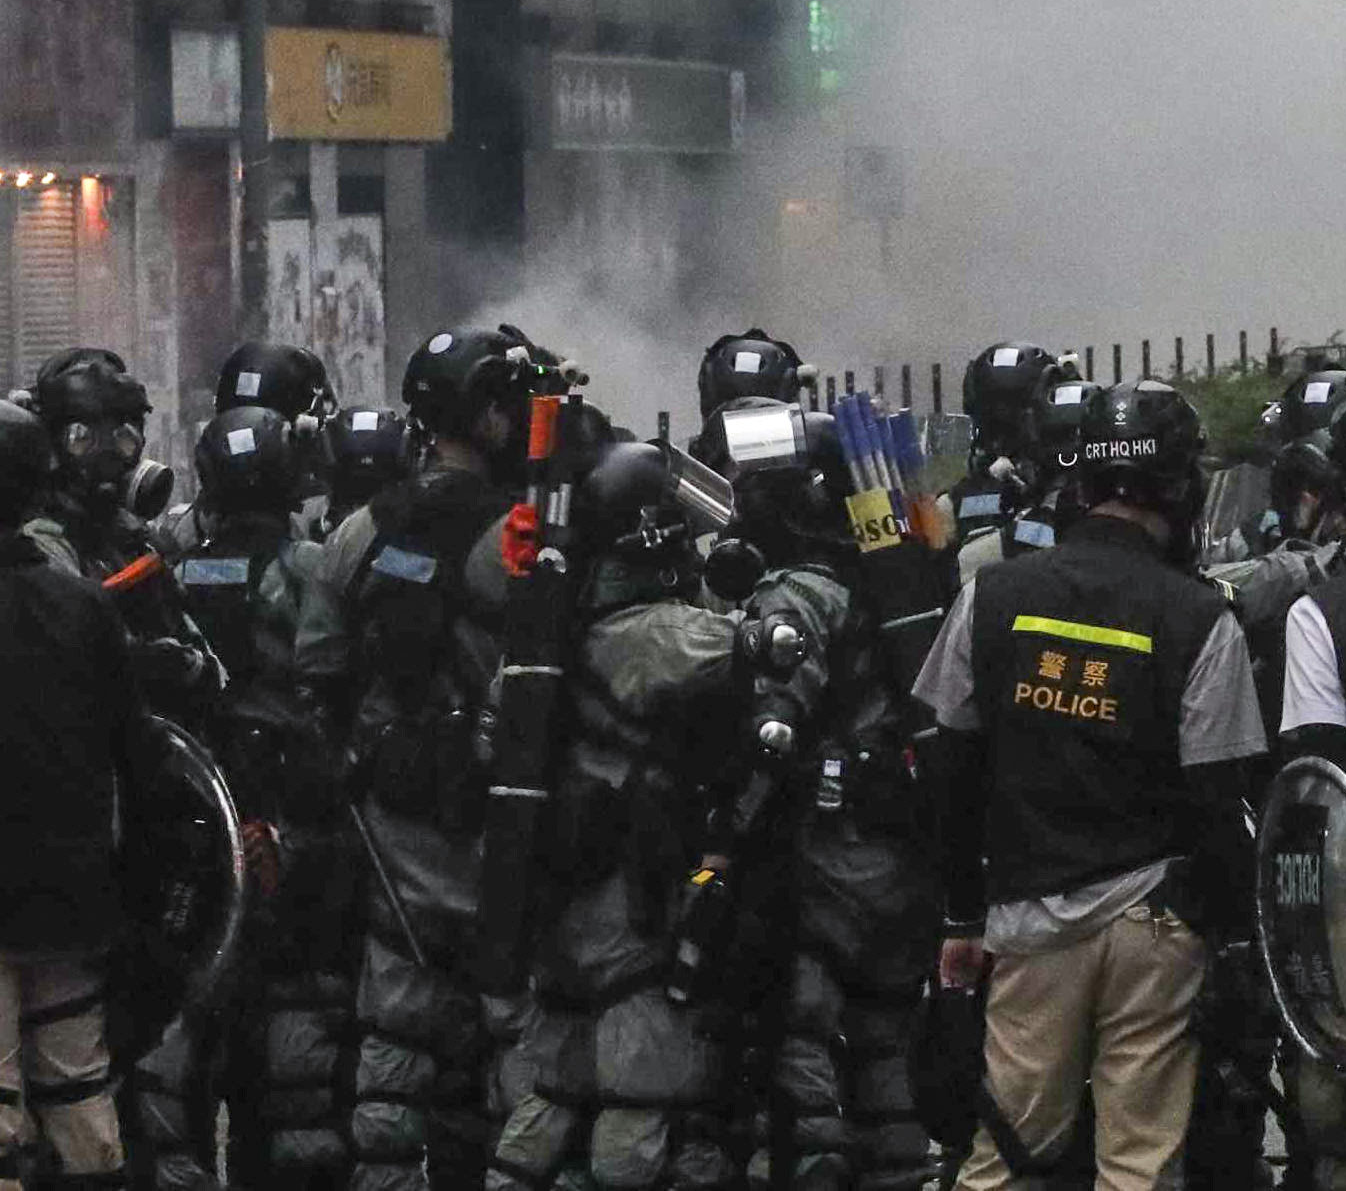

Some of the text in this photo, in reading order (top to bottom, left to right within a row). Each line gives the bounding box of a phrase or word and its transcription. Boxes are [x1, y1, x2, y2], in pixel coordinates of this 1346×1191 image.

[1085, 438, 1156, 459] CRT HQ HKI
[1038, 650, 1109, 687] 警察
[1014, 682, 1118, 721] POLICE
